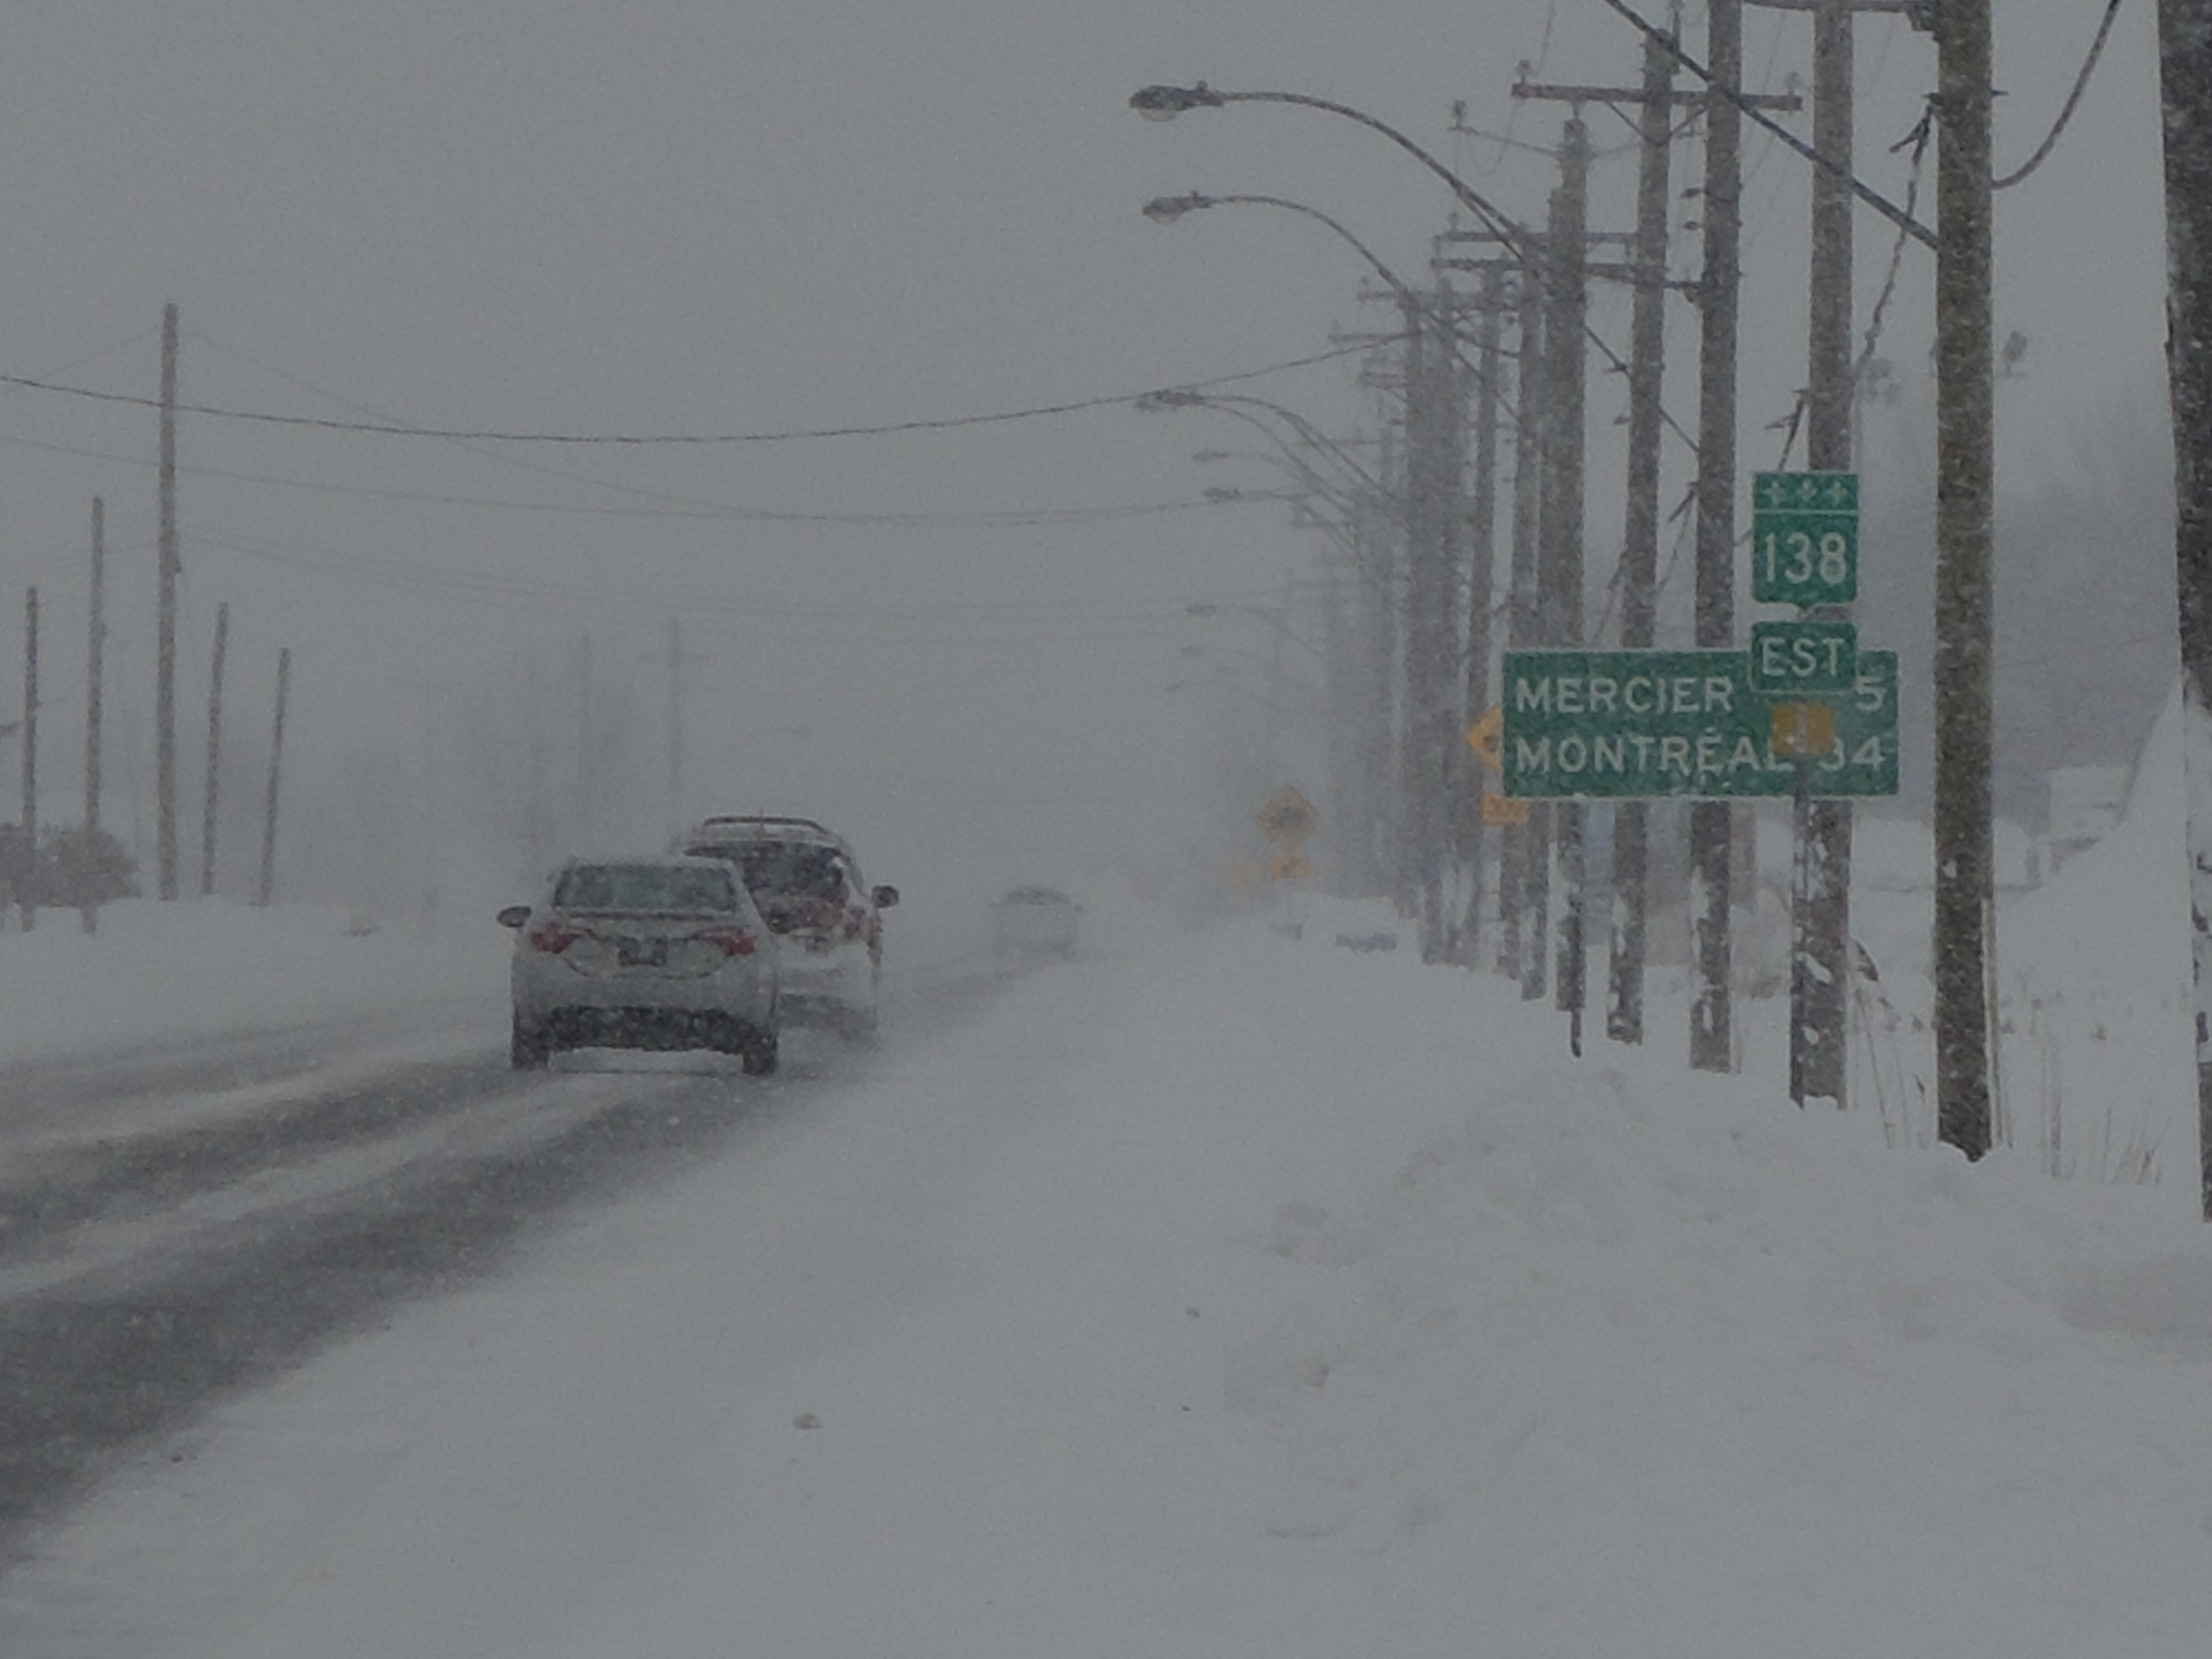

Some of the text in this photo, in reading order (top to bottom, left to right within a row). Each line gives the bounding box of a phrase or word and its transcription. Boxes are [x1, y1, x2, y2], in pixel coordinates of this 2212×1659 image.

[1764, 532, 1847, 583] 138
[1763, 639, 1845, 676] EST
[1517, 676, 1886, 713] MERCIER 5
